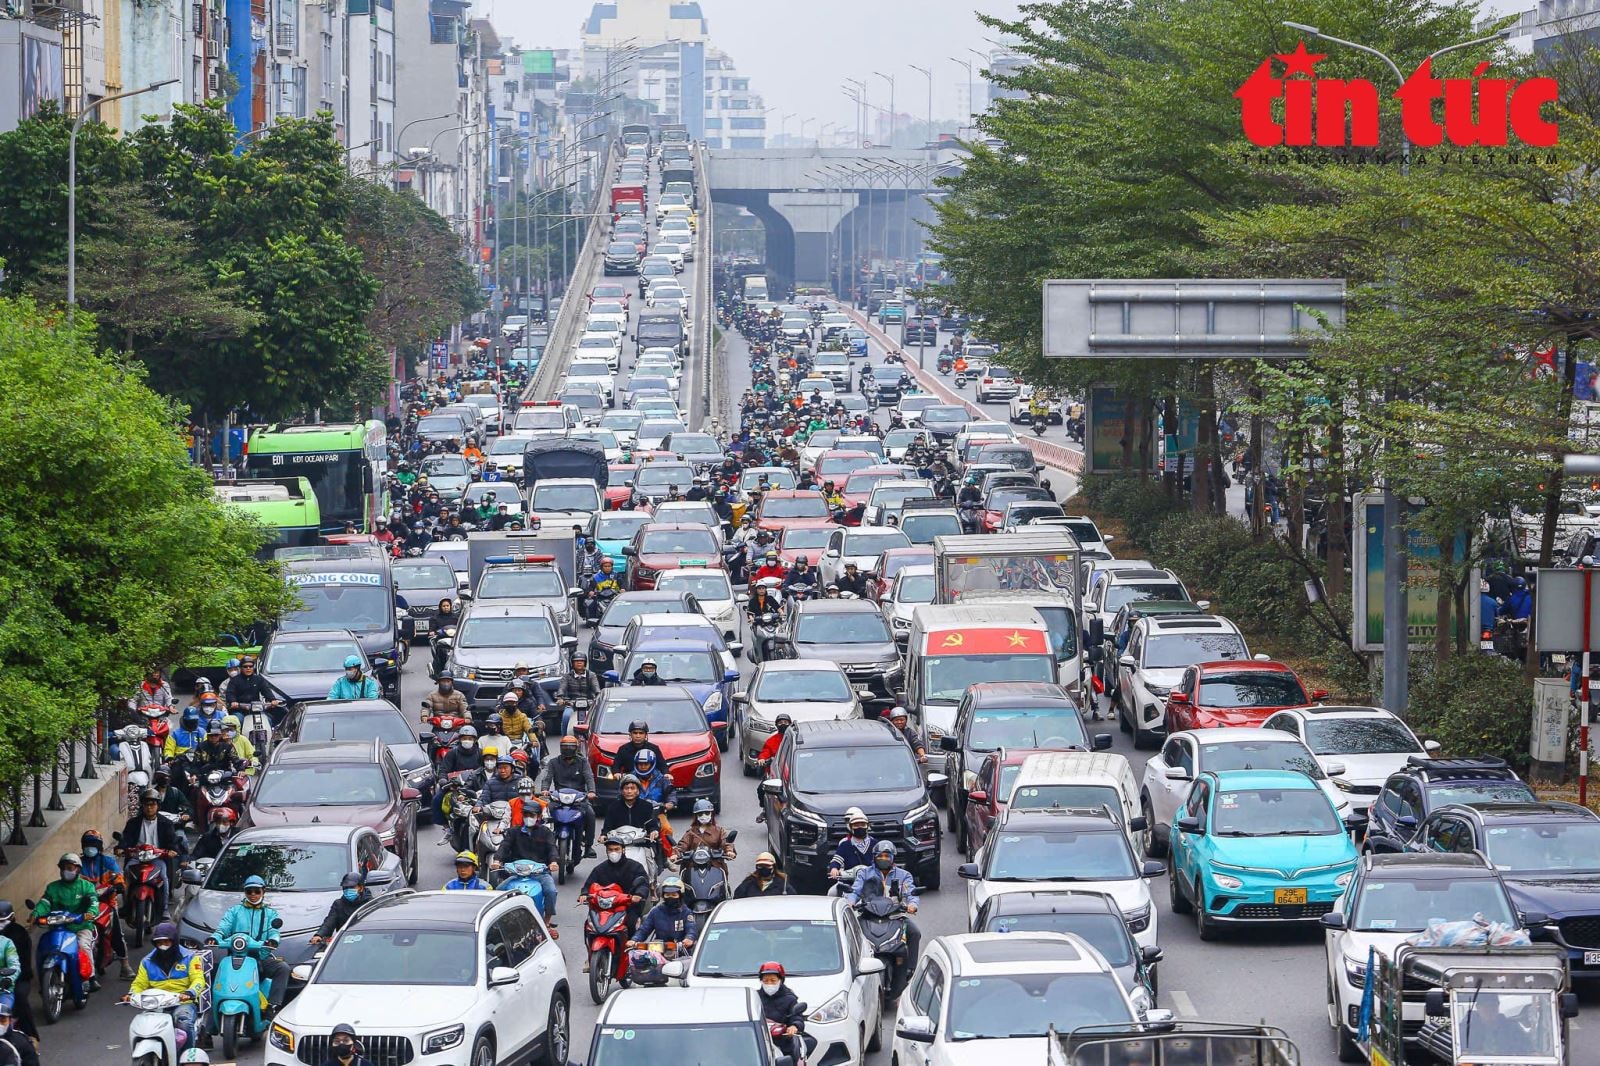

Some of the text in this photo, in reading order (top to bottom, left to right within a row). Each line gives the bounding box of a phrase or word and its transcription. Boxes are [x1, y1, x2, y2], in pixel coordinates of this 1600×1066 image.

[272, 455, 284, 465] E01
[305, 455, 324, 463] OCEAN
[1407, 625, 1437, 636] CITY
